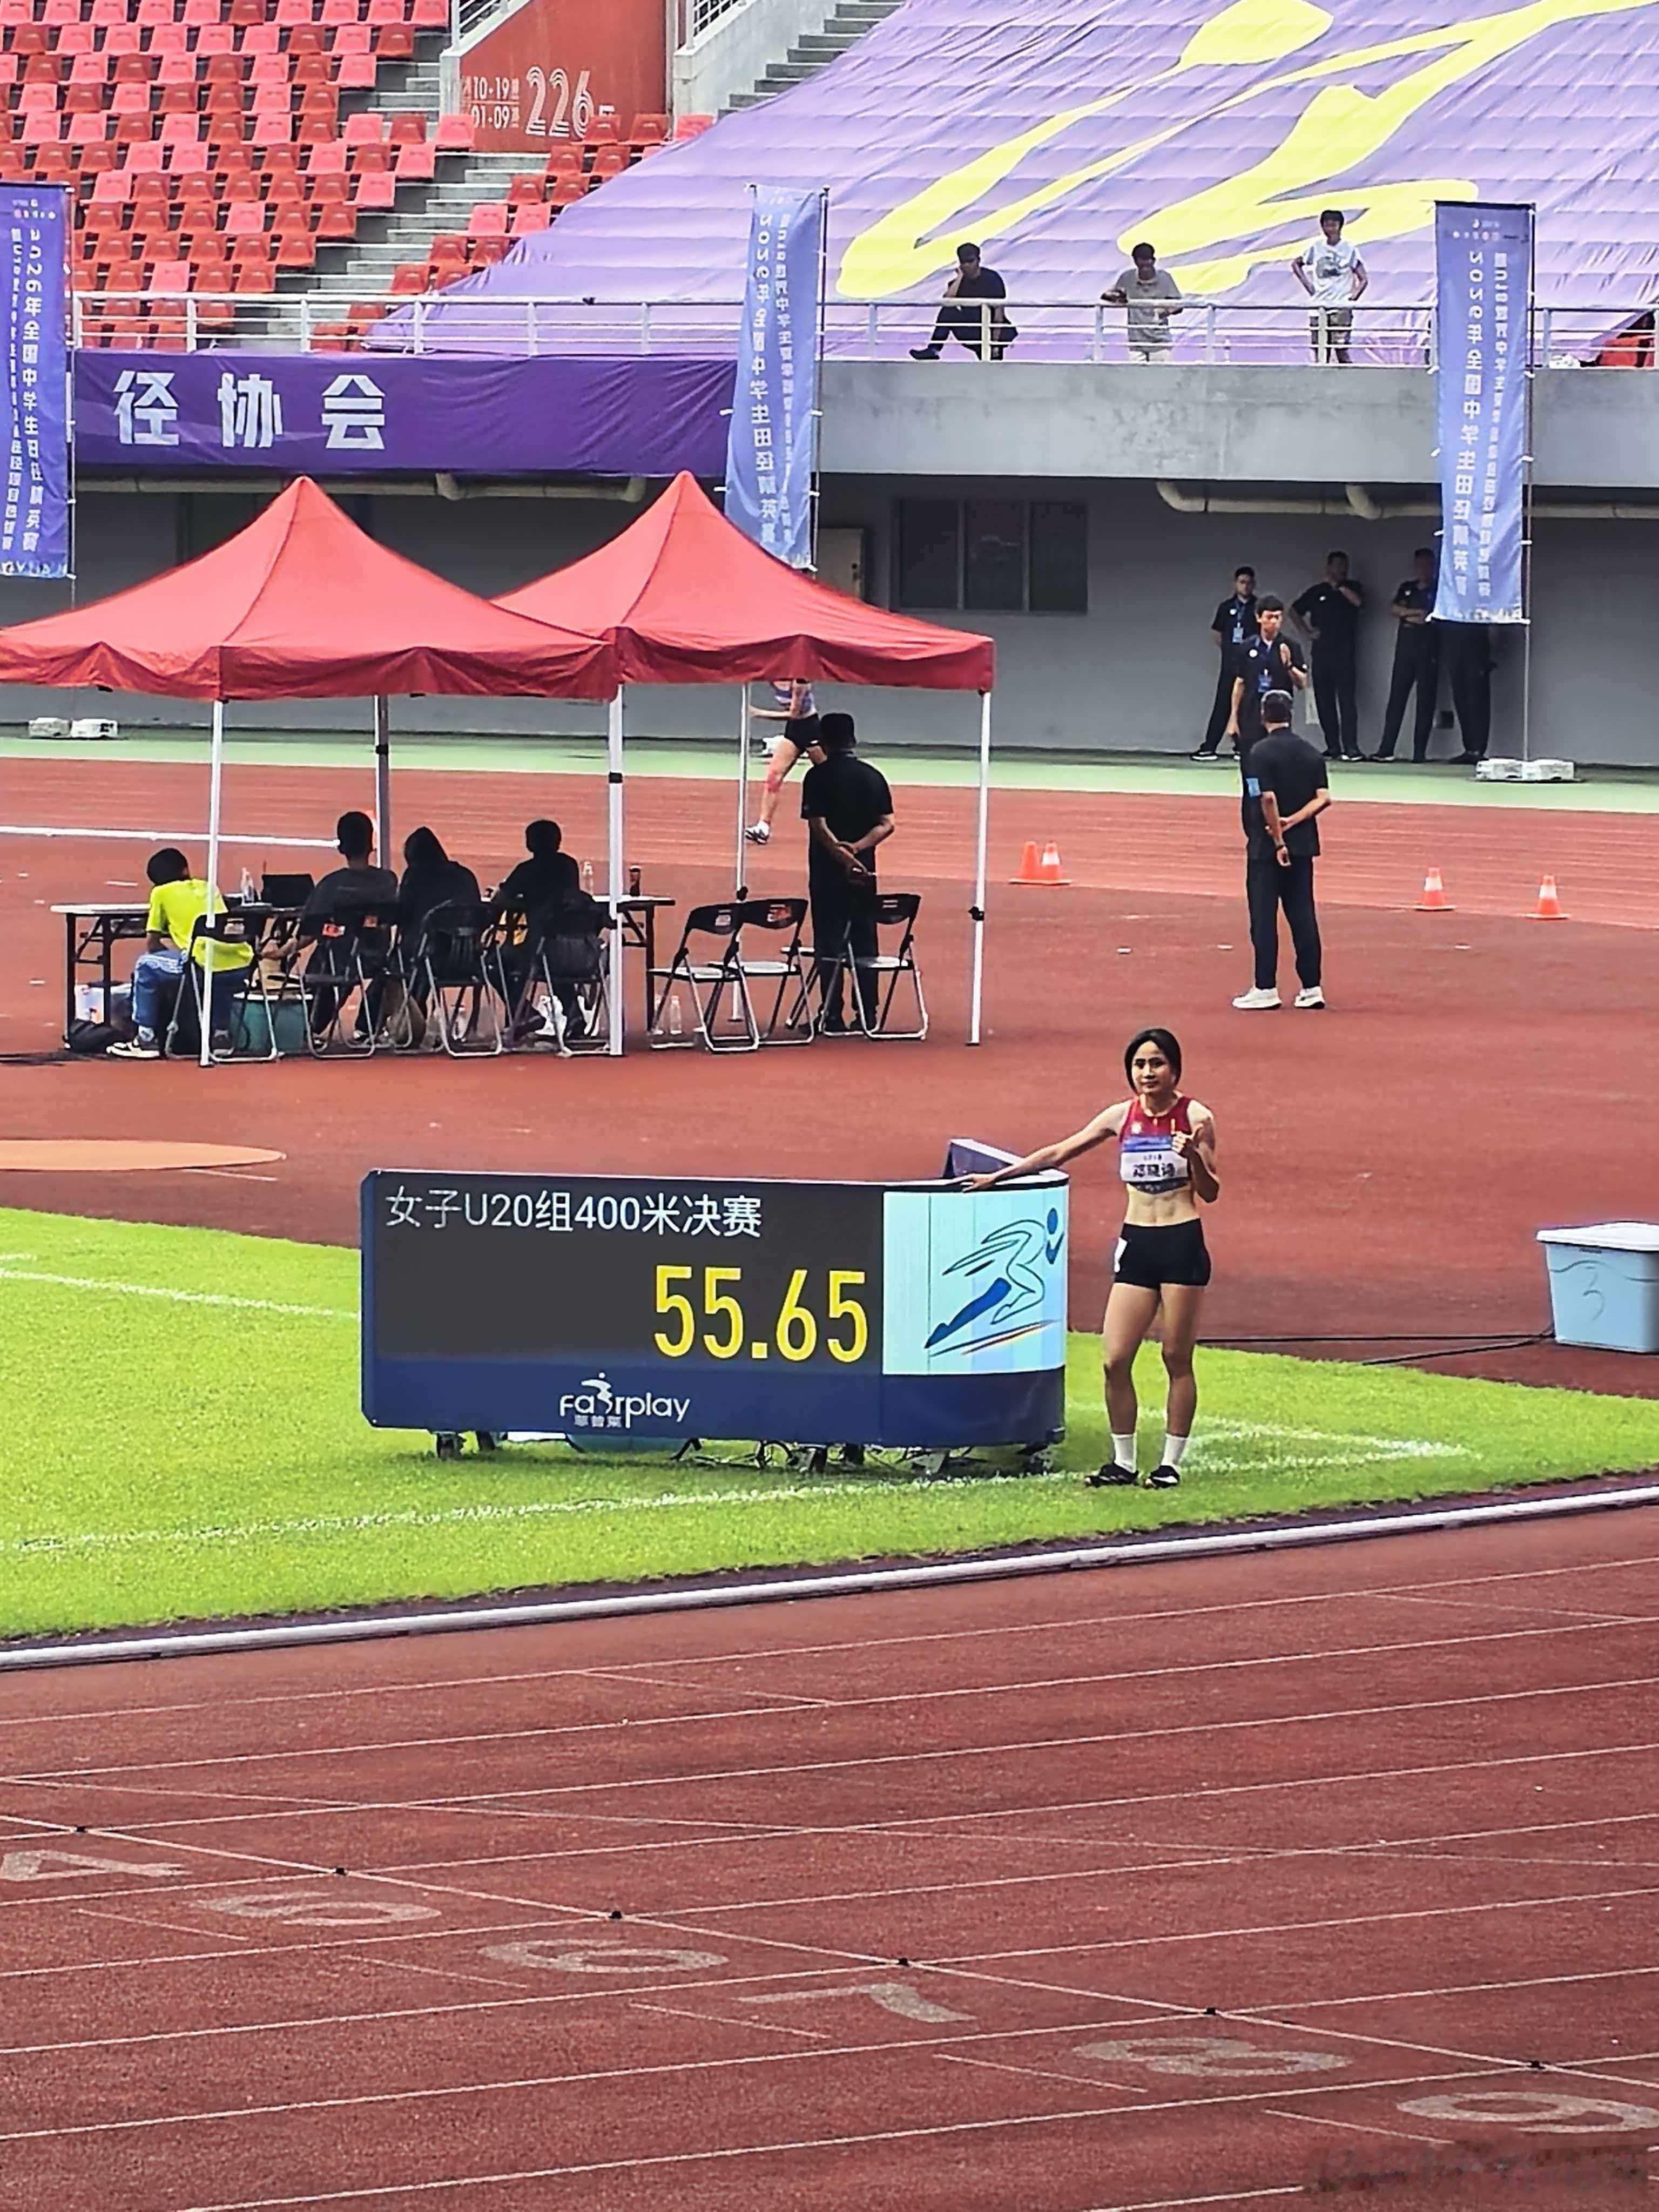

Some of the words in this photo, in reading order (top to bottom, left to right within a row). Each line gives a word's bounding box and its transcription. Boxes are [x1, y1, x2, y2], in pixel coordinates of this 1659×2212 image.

[113, 370, 385, 449] 径协会
[386, 1185, 761, 1238] 女子U20组400米决赛
[655, 1265, 868, 1363] 55.65
[194, 1891, 443, 1926] 5
[476, 1938, 731, 1974] 6
[736, 1981, 977, 2023] 7
[1071, 2036, 1354, 2078] 8
[1394, 2090, 1659, 2135] 9
